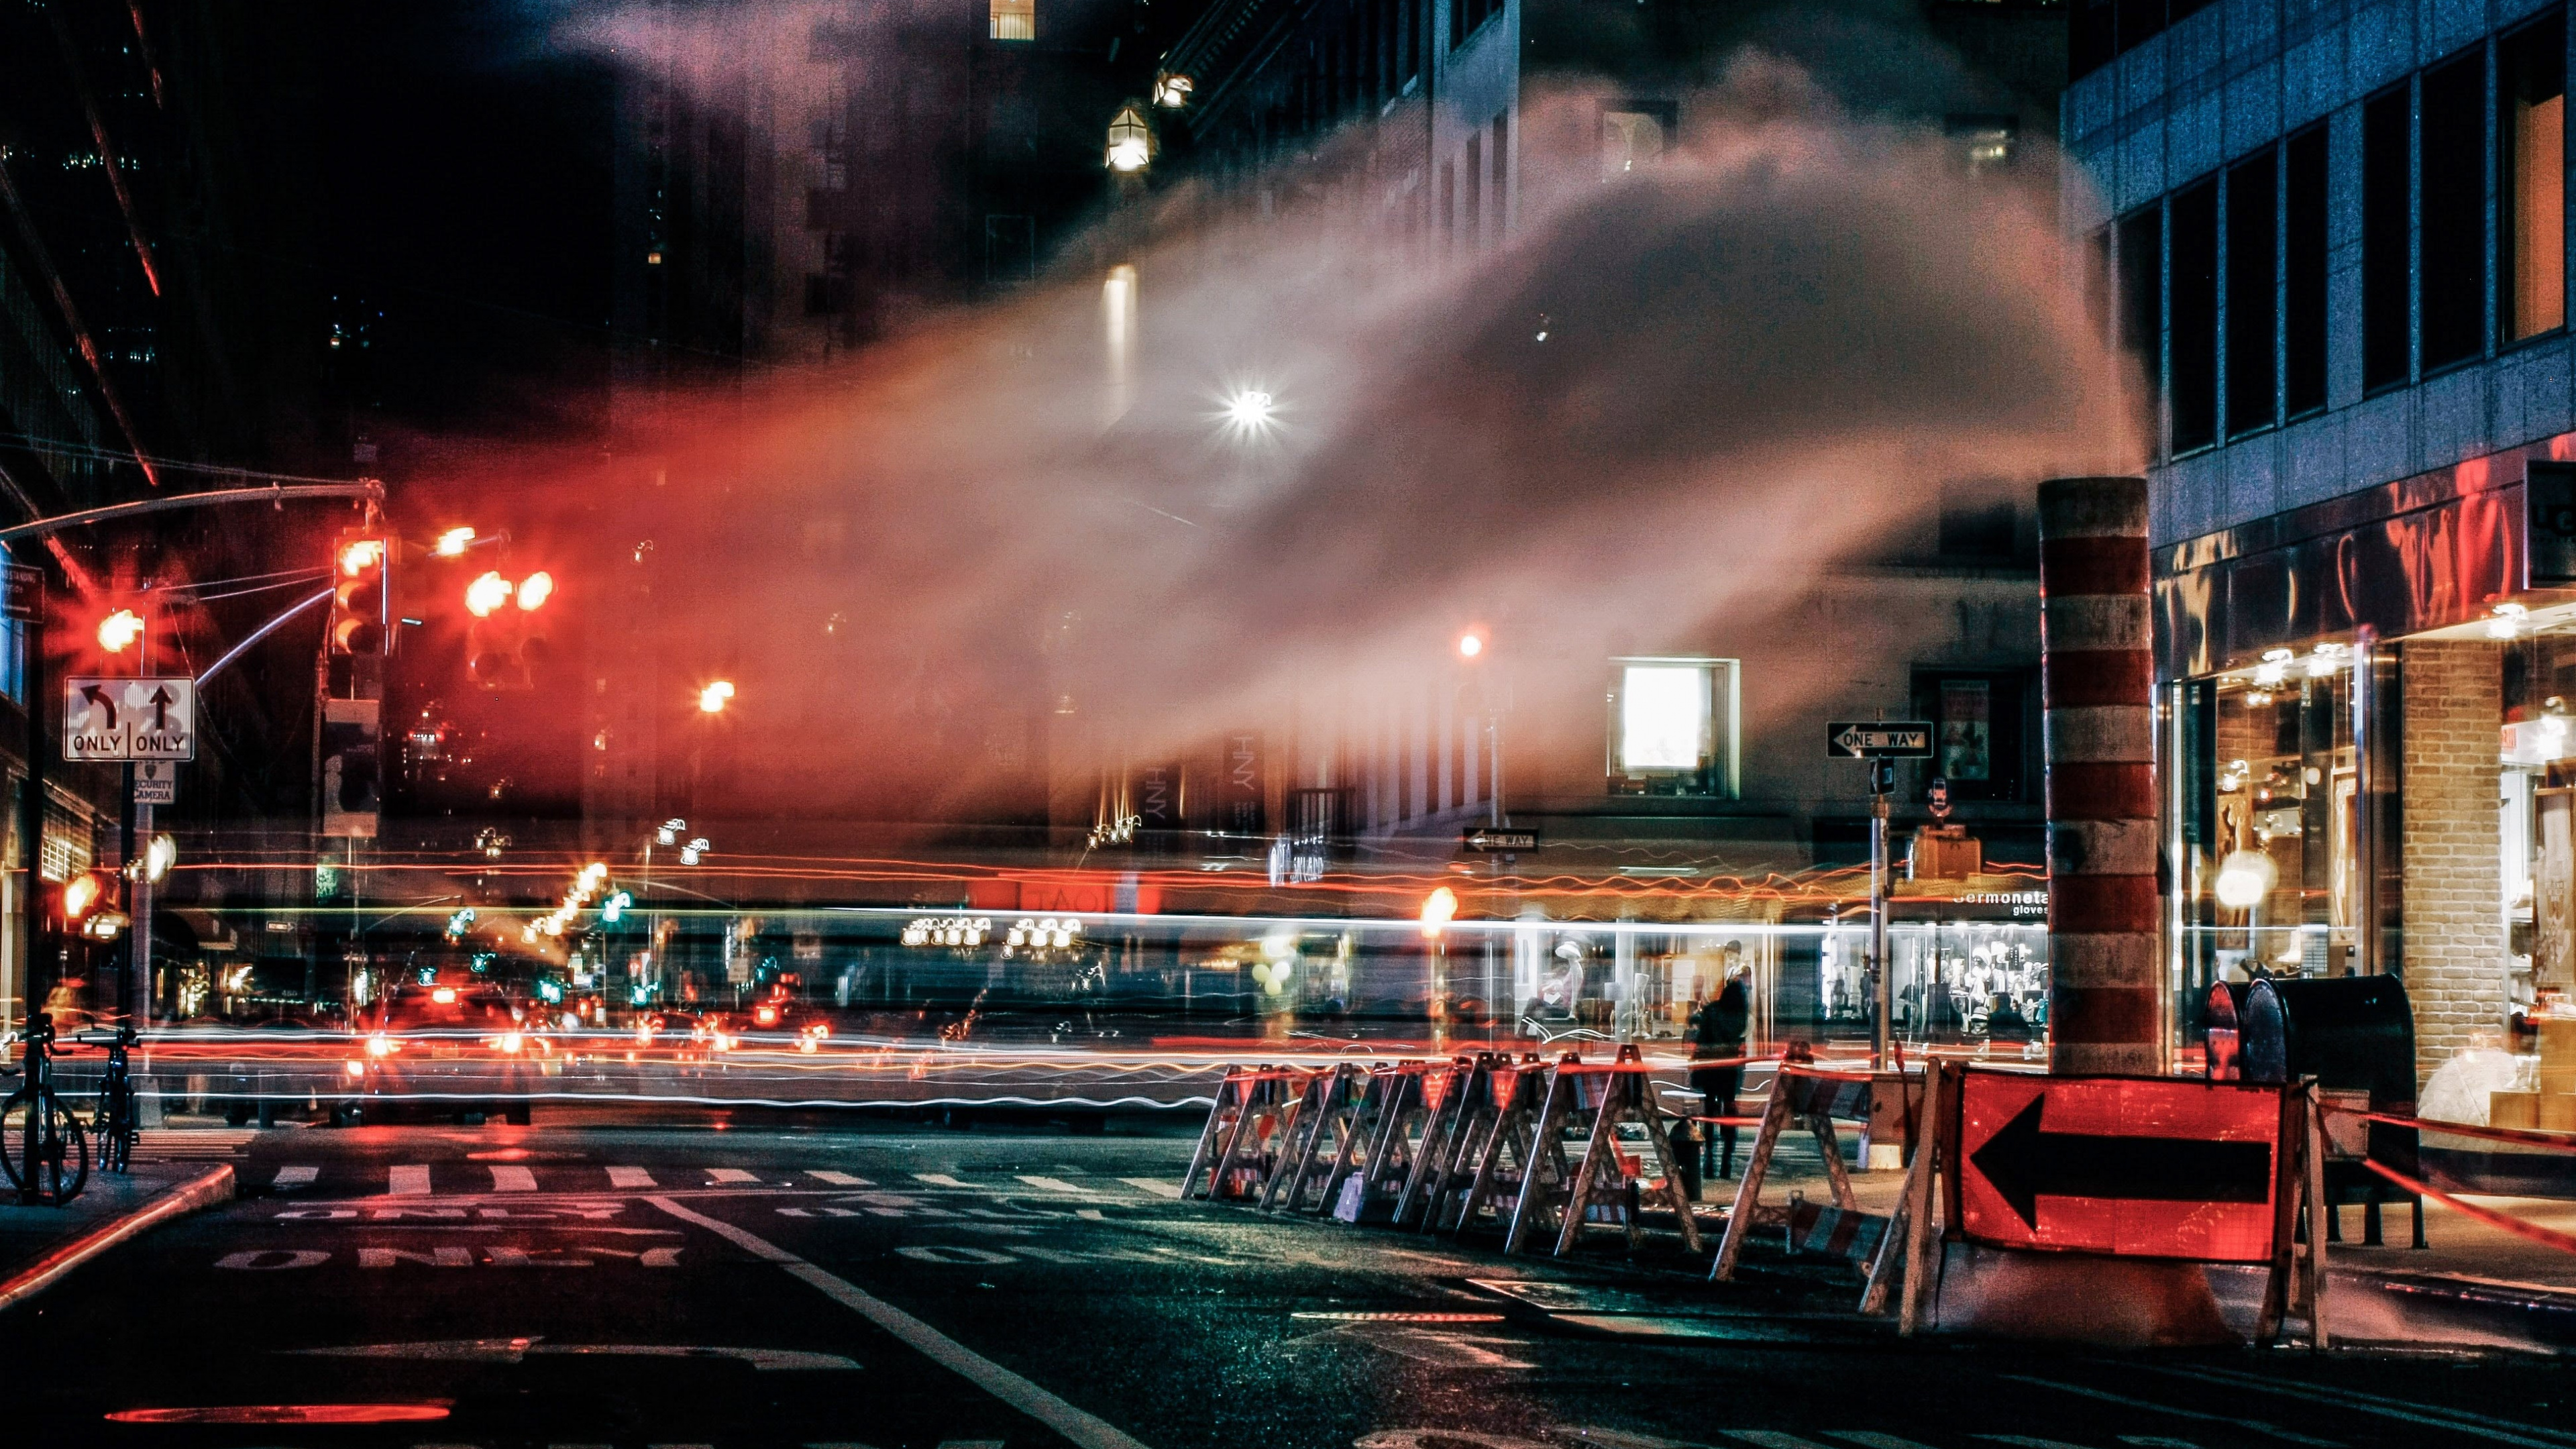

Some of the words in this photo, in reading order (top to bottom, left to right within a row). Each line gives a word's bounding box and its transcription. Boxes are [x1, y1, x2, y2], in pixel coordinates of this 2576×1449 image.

[74, 735, 121, 751] ONLY
[136, 735, 184, 751] ONLY
[1843, 733, 1874, 747] ONE
[1887, 733, 1919, 747] WAY
[135, 780, 173, 790] ECURITY
[133, 789, 170, 800] CAMERA
[1505, 836, 1529, 847] WAY
[2012, 905, 2049, 916] gloves
[272, 1208, 626, 1219] ONLY
[211, 1246, 686, 1271] ONLY
